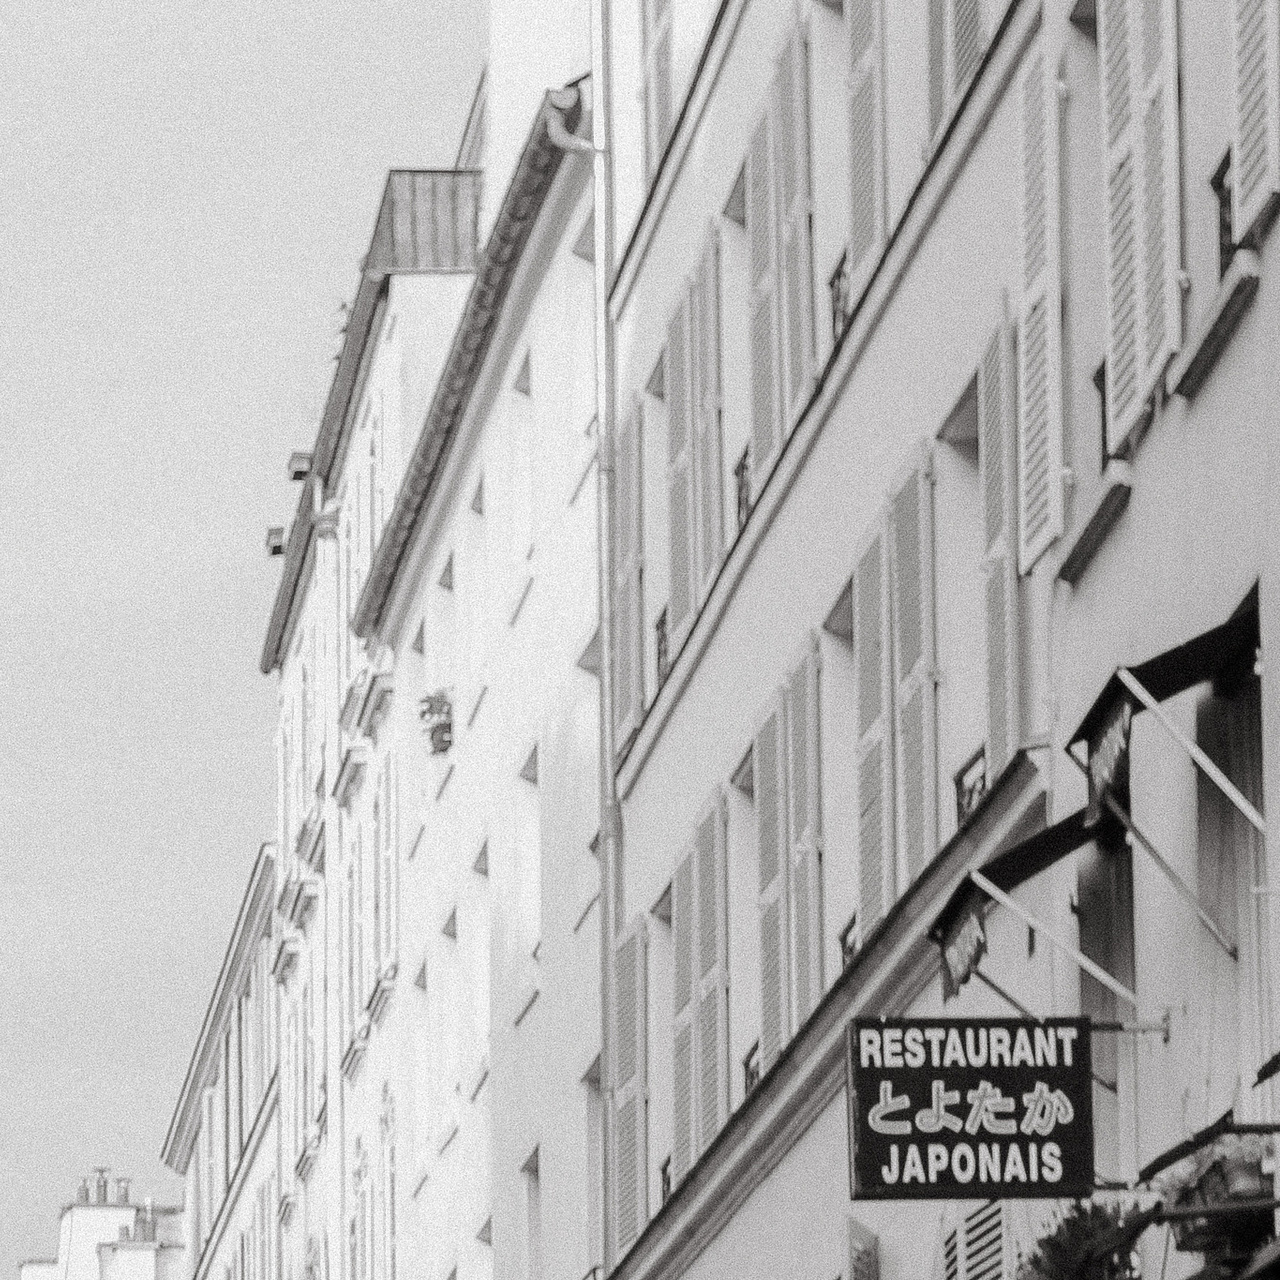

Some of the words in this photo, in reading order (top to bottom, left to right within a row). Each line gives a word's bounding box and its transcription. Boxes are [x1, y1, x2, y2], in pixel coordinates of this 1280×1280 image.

[859, 1026, 1078, 1069] RESTAURANT
[867, 1079, 1075, 1136] とよたか
[880, 1141, 1063, 1185] JAPONAIS
